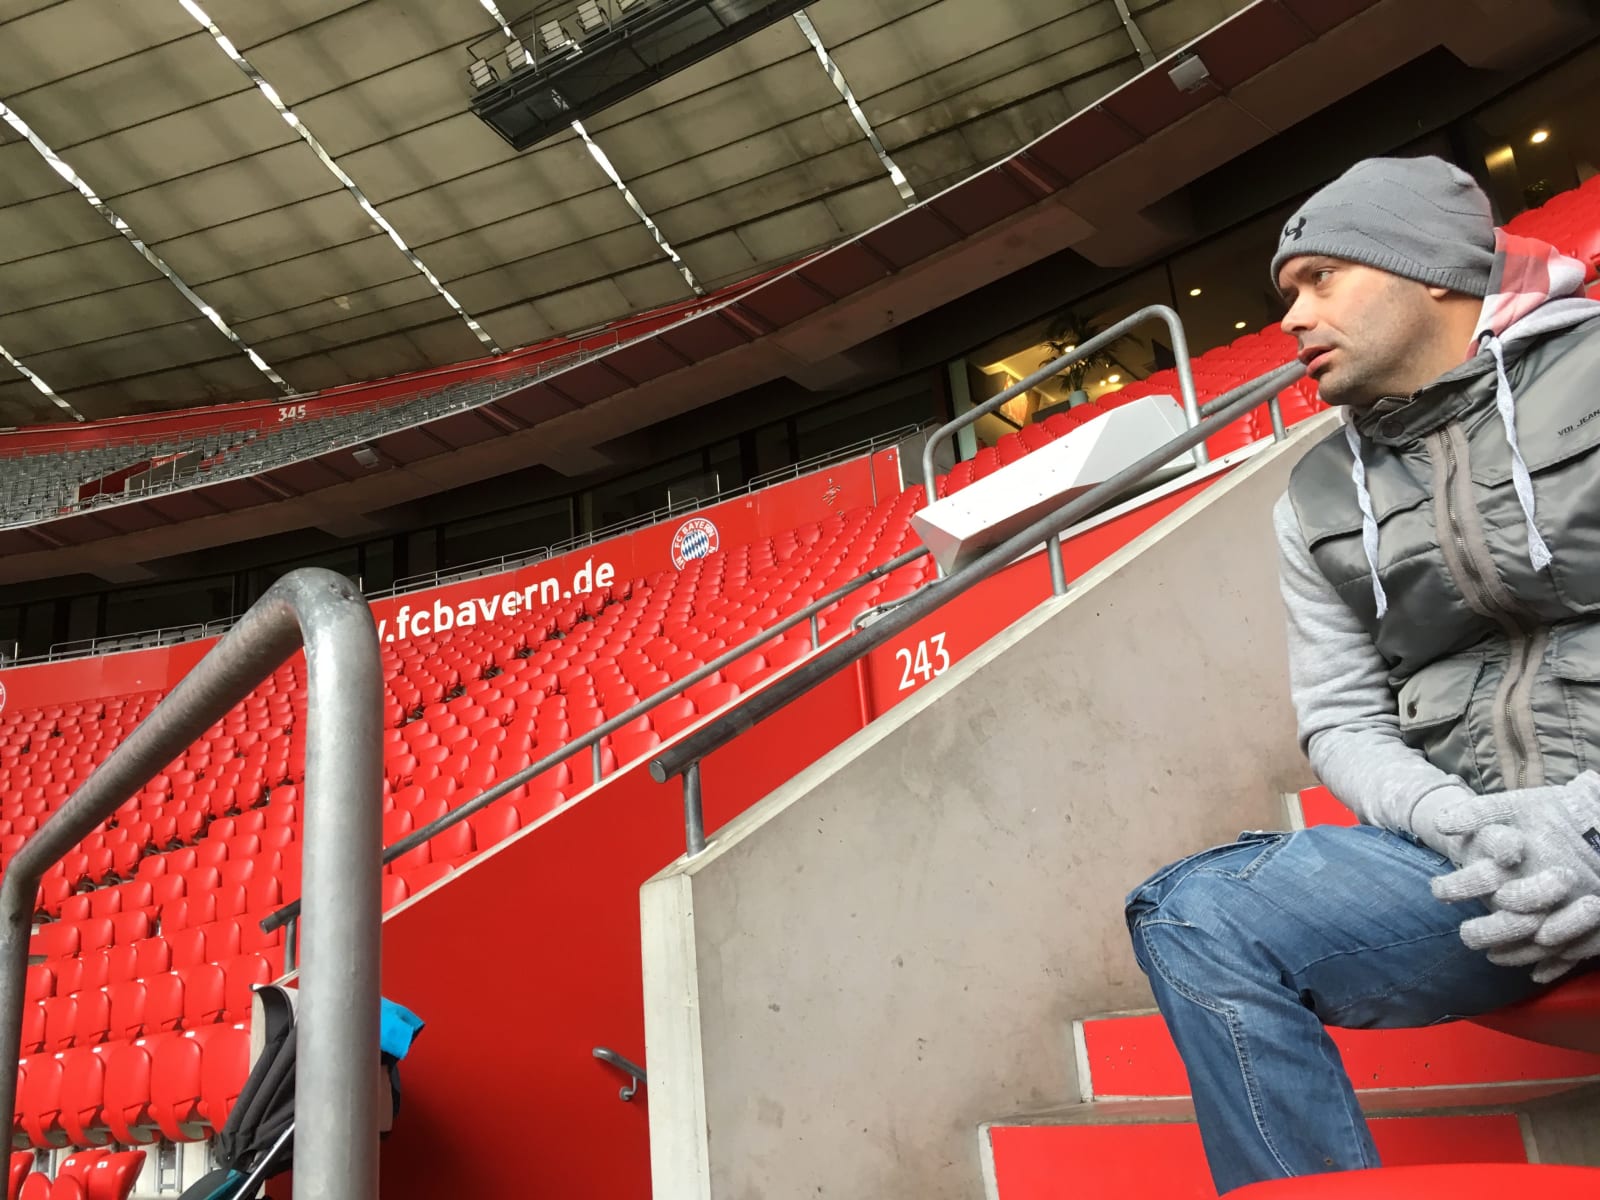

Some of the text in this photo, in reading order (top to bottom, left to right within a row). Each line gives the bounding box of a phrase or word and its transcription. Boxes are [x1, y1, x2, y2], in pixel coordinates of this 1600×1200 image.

[278, 404, 306, 422] 345
[682, 520, 716, 538] BAYERN
[895, 631, 950, 691] 243
